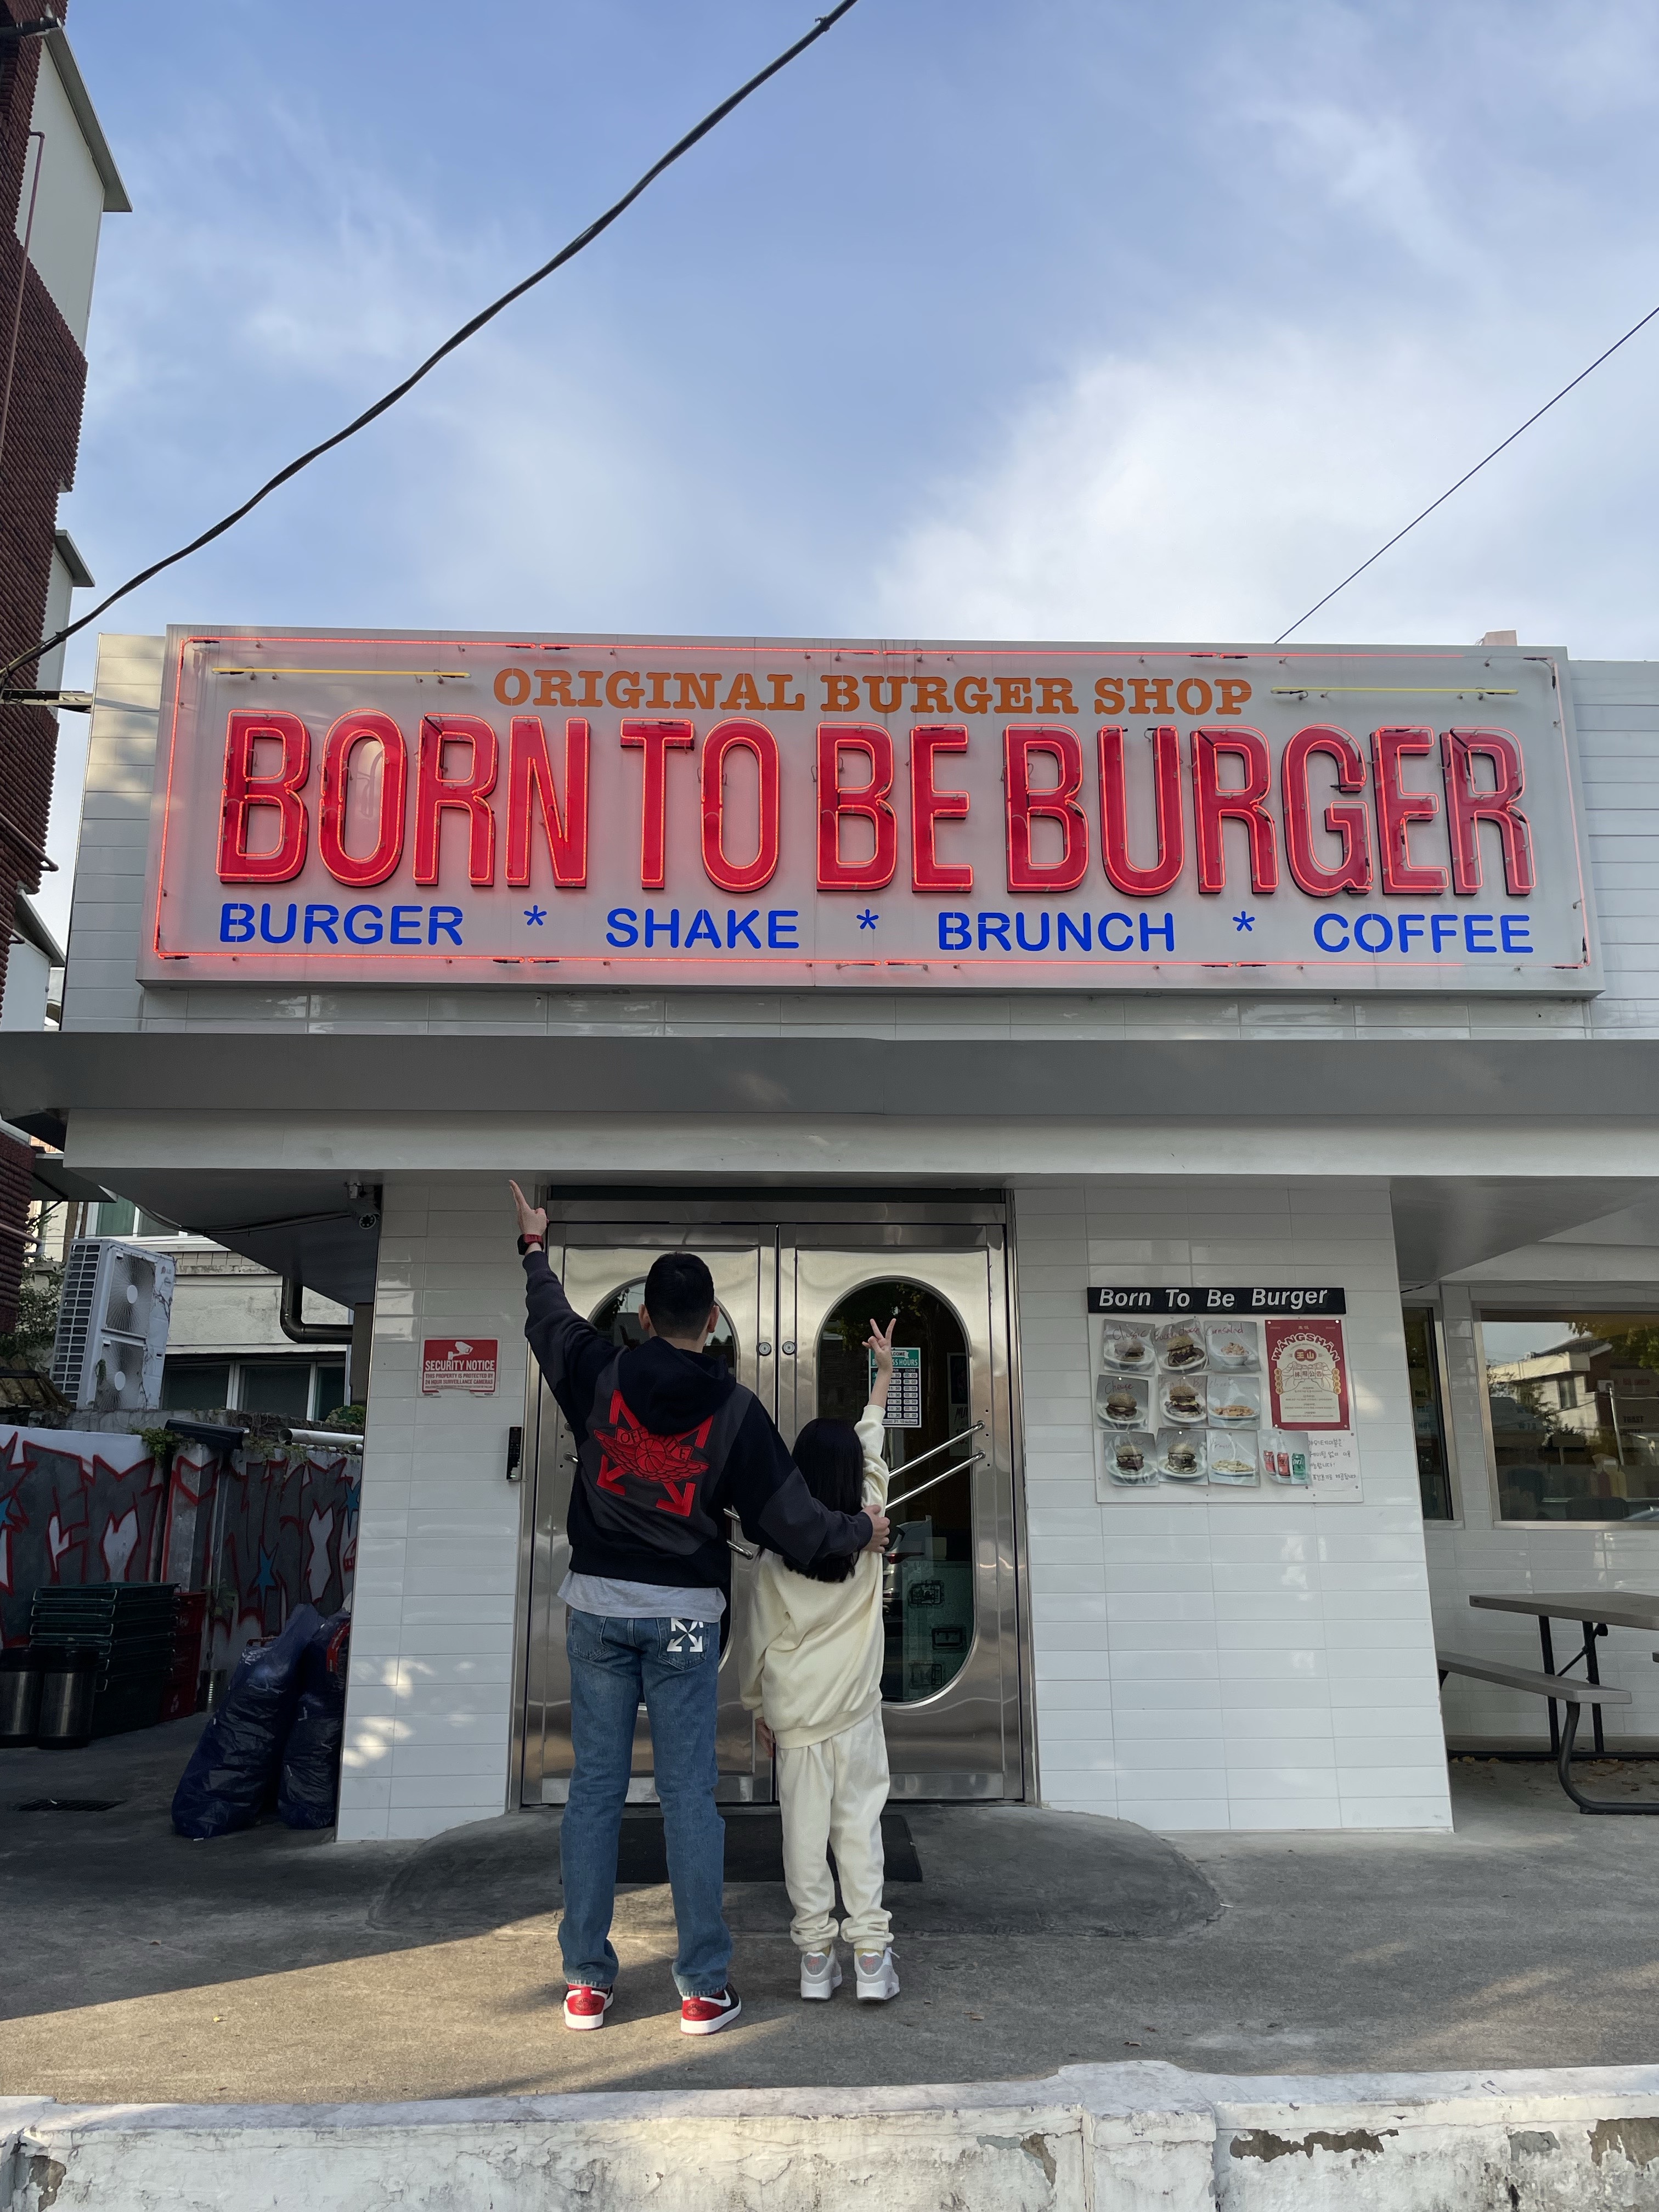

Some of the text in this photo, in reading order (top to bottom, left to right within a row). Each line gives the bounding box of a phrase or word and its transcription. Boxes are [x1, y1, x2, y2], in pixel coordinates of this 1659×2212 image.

[494, 668, 1252, 715] ORIGINAL BURGER SHOP
[216, 709, 1537, 898] BORN TO BE BURGER
[220, 903, 1534, 953] BURGER SHAKE BRUNCH COFFEE
[1099, 1288, 1328, 1311] Born To Be Burger
[425, 1359, 495, 1372] SECURITY NOTICE
